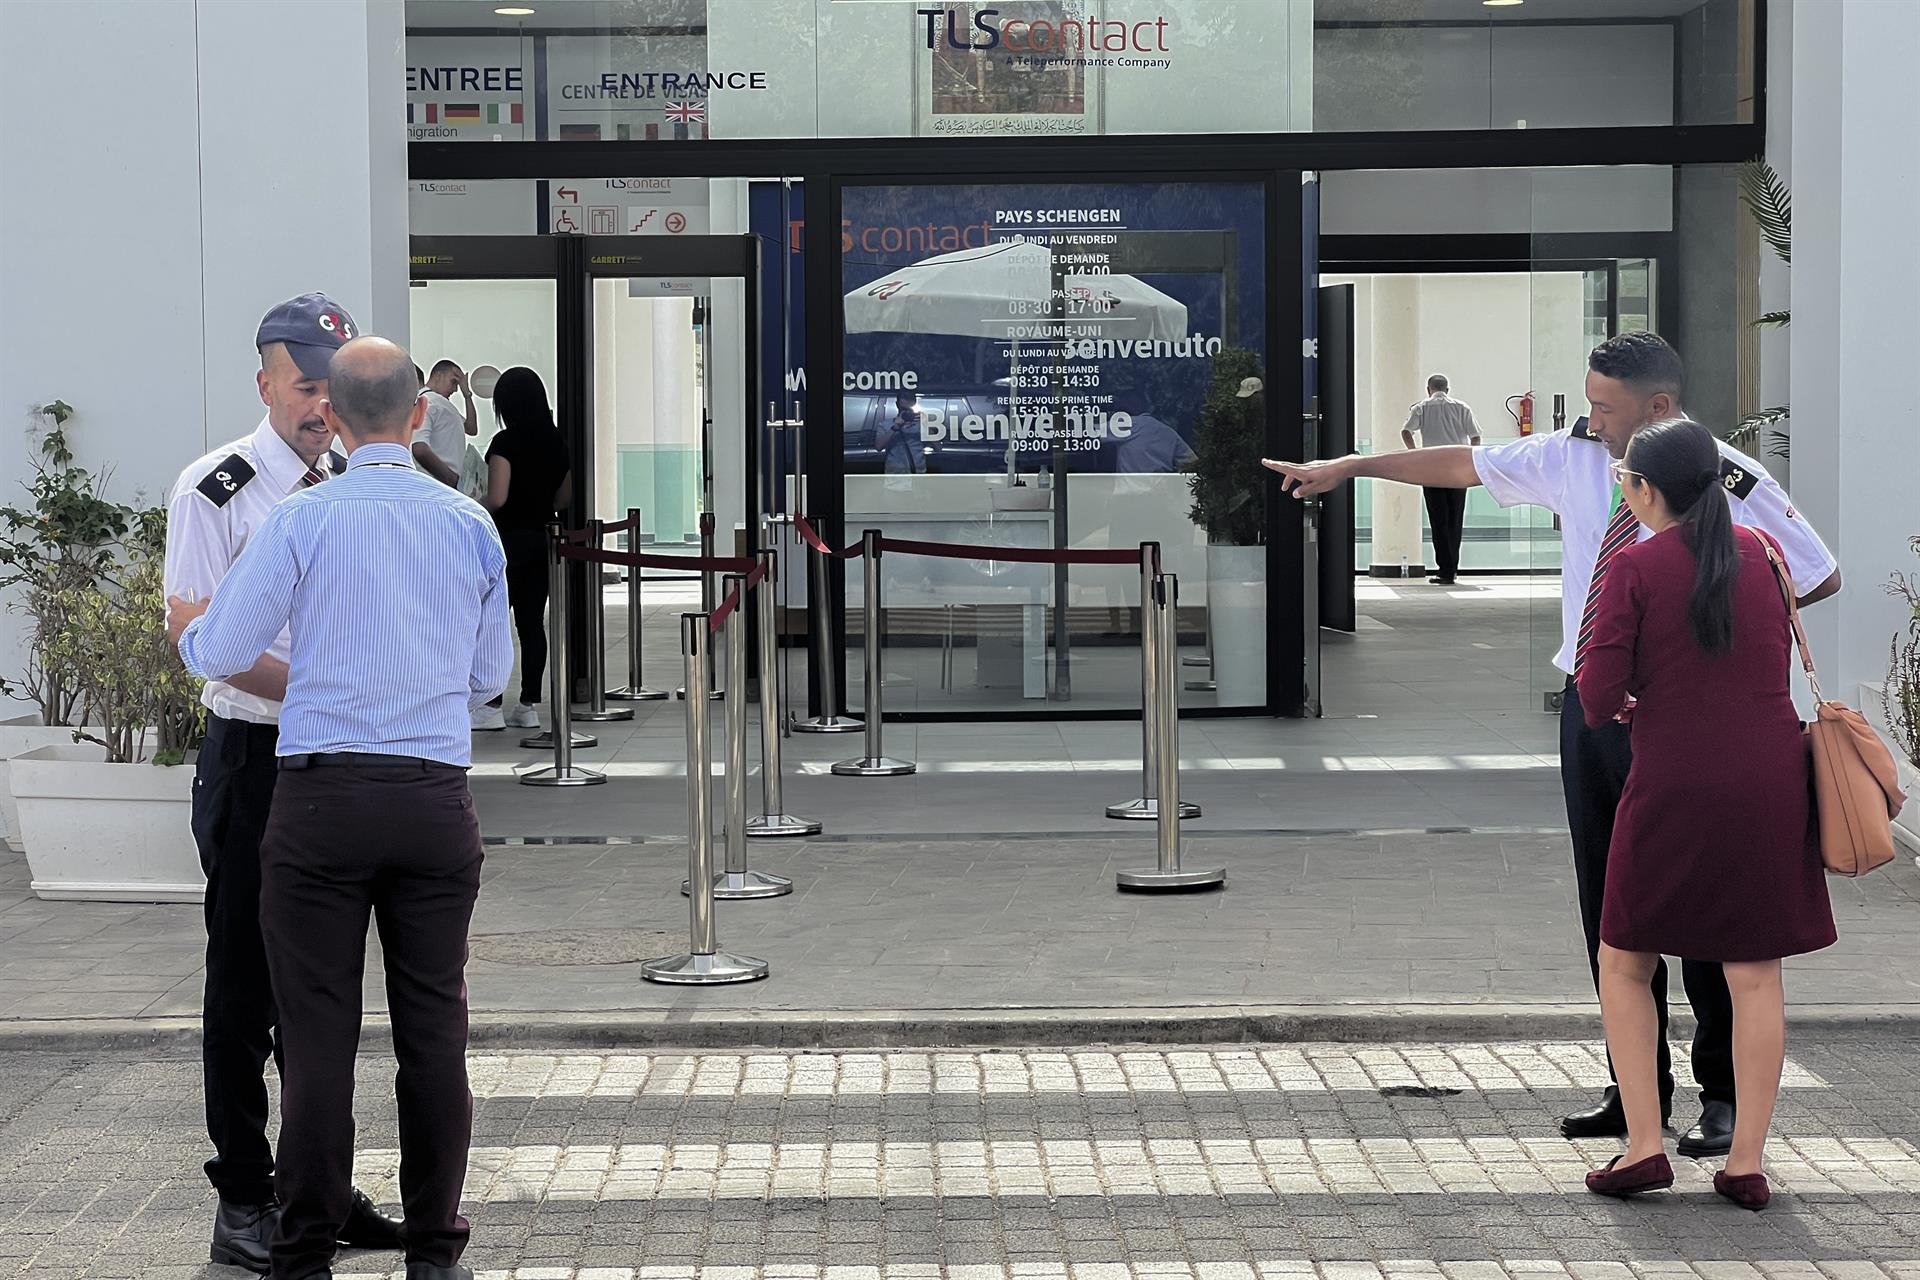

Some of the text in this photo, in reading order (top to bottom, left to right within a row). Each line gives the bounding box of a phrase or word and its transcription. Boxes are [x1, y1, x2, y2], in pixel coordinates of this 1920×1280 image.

[917, 9, 1169, 52] TLScontact
[1006, 57, 1171, 69] A Teleperformance Company
[406, 67, 523, 91] ENTREE
[601, 72, 767, 91] ENTRANCE
[562, 82, 708, 100] CENTRE DE VISAS
[995, 209, 1120, 223] PAYS SCHENGEN
[1050, 236, 1064, 245] AU
[1066, 235, 1117, 244] VENDREDI
[408, 256, 437, 264] ARRETT
[1060, 255, 1109, 263] DEMANDE
[1008, 301, 1051, 314] 08:30
[1068, 300, 1111, 314] 17:00
[1007, 325, 1102, 337] ROYAUME-UNI
[1003, 349, 1016, 357] DU
[1018, 349, 1045, 357] LUNDI
[1047, 349, 1059, 357] AU
[1010, 364, 1100, 374] DÉPÔT DE DEMANDE
[1010, 376, 1048, 387] 08:30
[1062, 375, 1100, 387] 14:30
[997, 395, 1113, 405] RENDEZ-VOUS PRIME TIME
[1011, 440, 1049, 451] 09:00
[1063, 439, 1101, 451] 13:00
